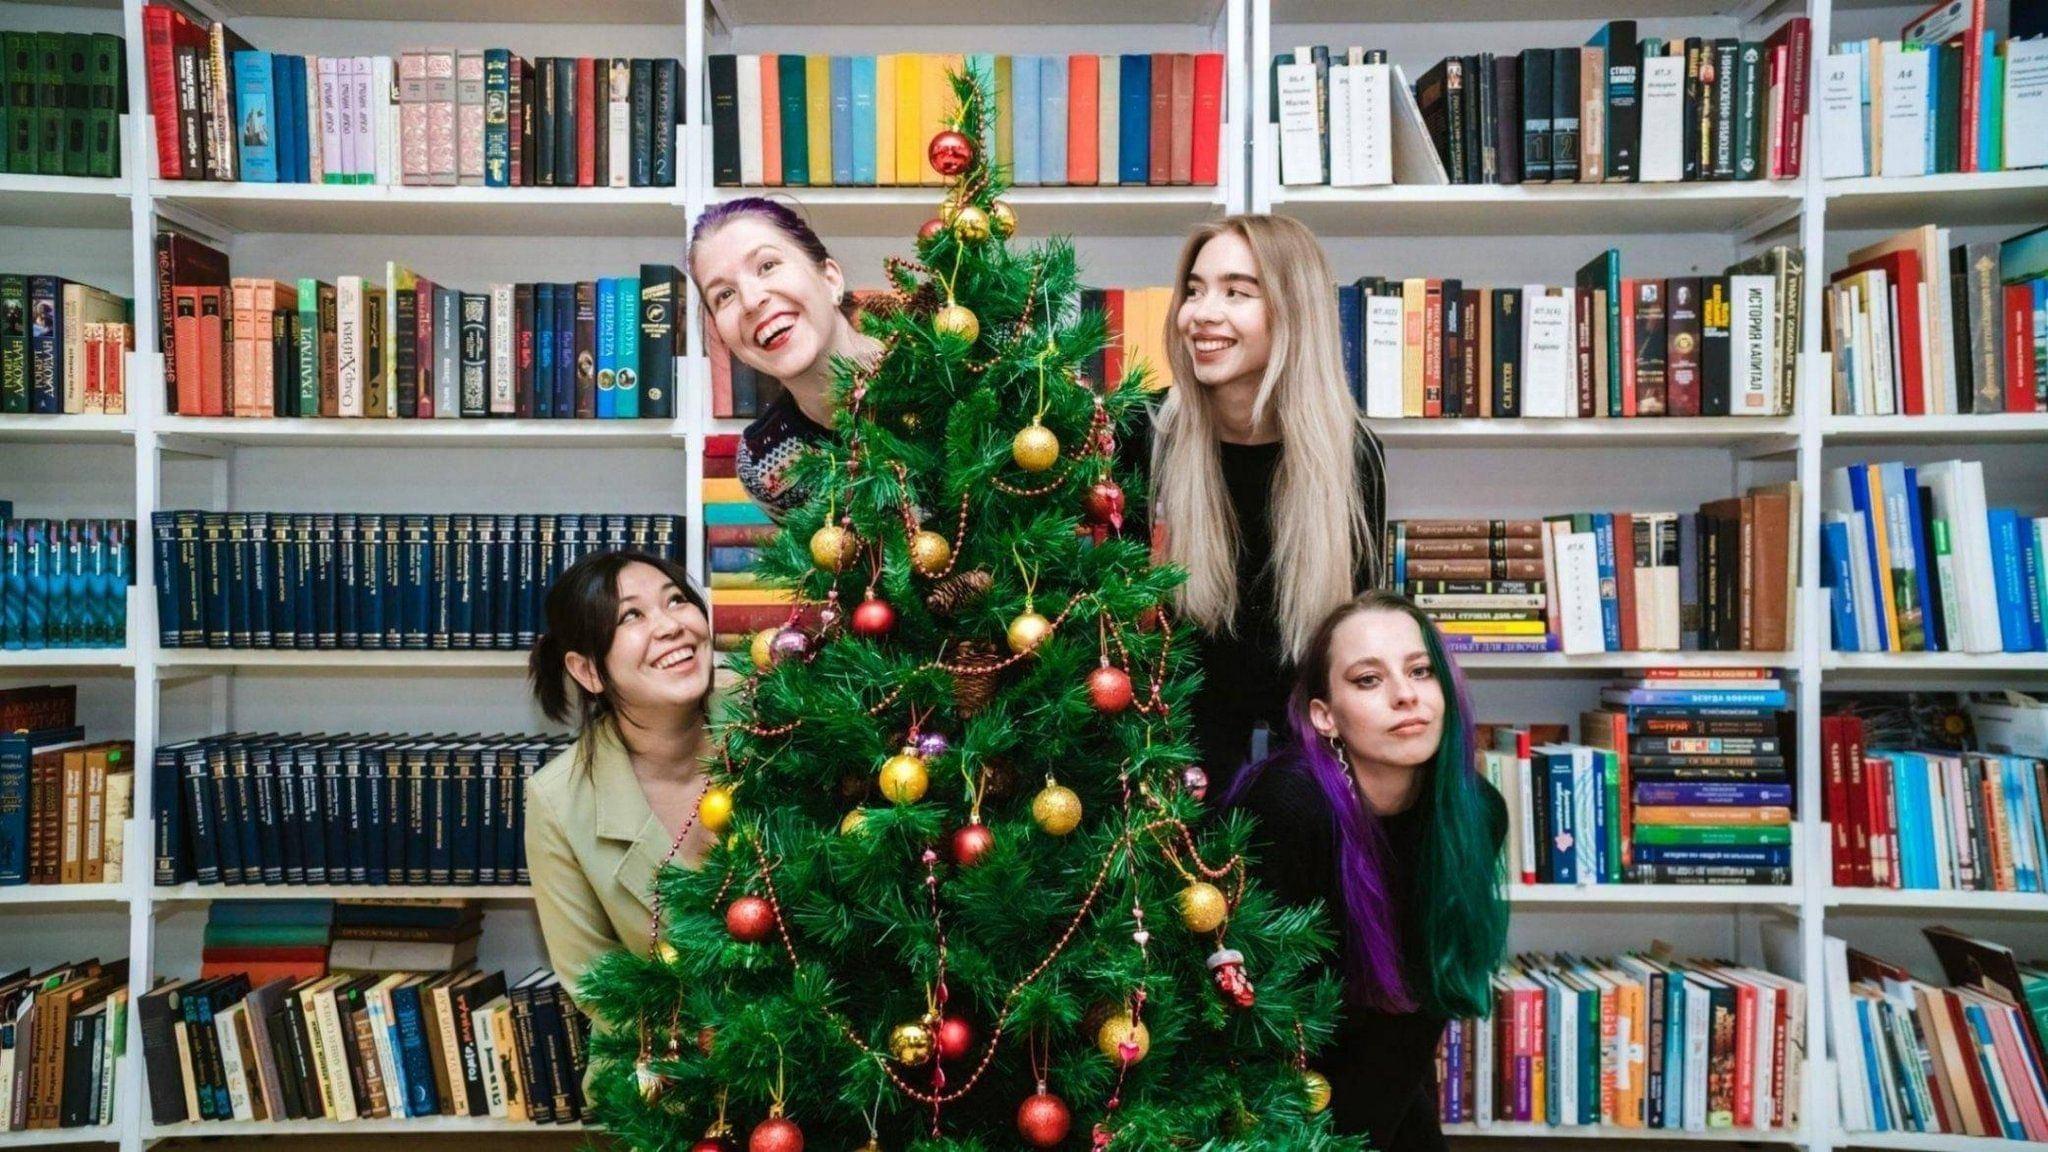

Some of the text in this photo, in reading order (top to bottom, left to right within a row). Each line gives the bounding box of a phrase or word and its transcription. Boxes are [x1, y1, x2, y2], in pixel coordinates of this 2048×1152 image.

[1719, 55, 1731, 165] ИСТОРИЯ ФИЛОСОФИИ
[656, 158, 666, 175] 2
[605, 292, 615, 357] ЛИТЕРАТУРА
[625, 291, 635, 356] ЛИТЕРАТУРА
[1749, 288, 1763, 391] ИСТОРИЯ КАПИТАЛ
[3, 348, 13, 388] РОБЕРТ
[13, 340, 25, 397] ДЖОРДАН
[34, 350, 43, 388] РОБЕРТ
[43, 340, 54, 398] ДЖОРДАН
[164, 334, 176, 382] ЭРНЕСТ
[90, 545, 97, 553] 7
[89, 865, 96, 875] 2
